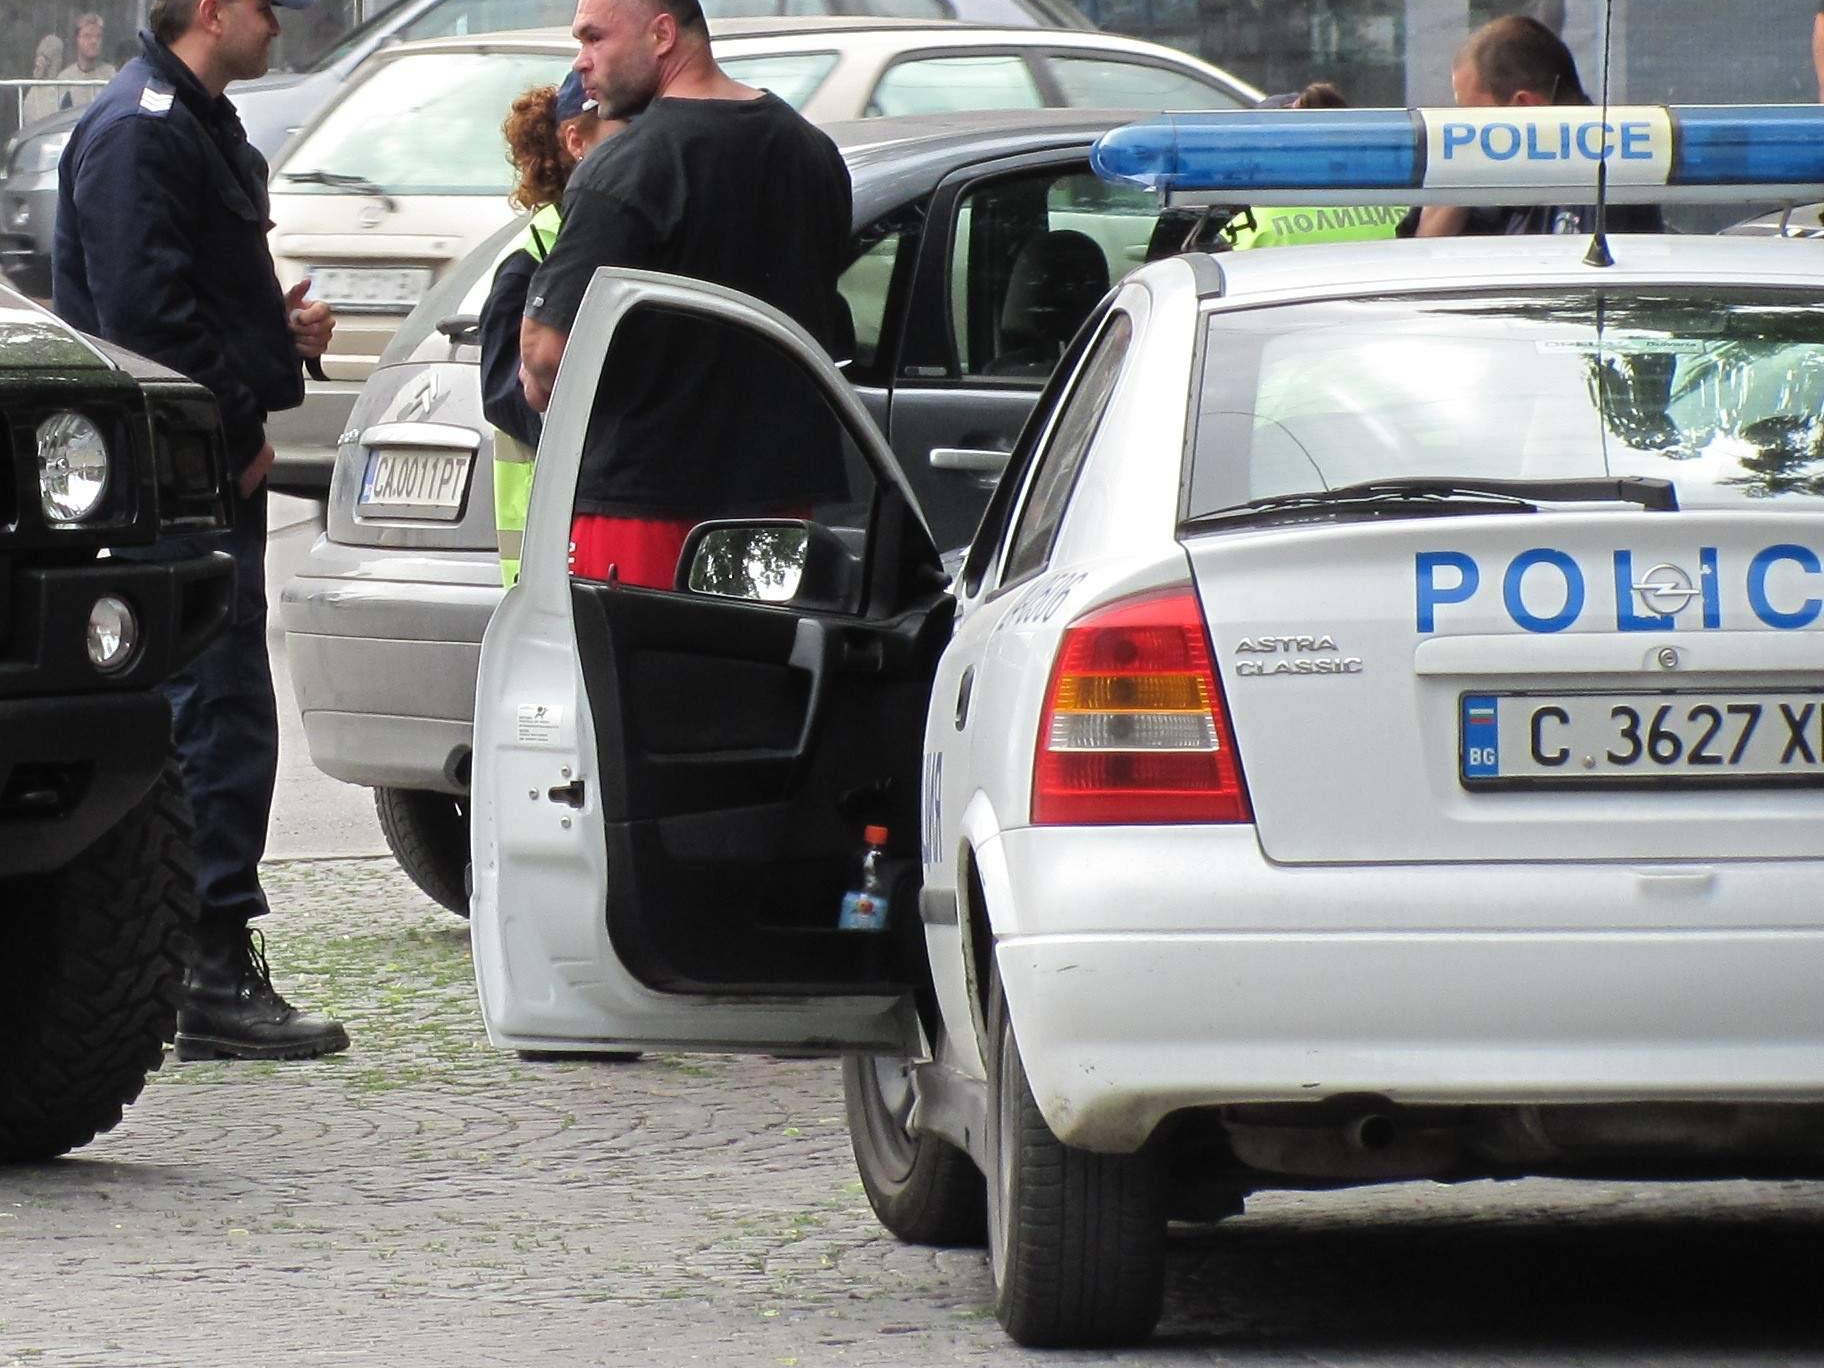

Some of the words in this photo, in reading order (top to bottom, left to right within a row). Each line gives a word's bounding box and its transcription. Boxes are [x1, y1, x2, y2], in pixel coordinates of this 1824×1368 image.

[1442, 121, 1653, 161] POLICE
[1235, 635, 1339, 654] ASTRA
[1236, 657, 1363, 676] CLASSIC
[1780, 703, 1824, 764] X
[1469, 748, 1495, 765] BG
